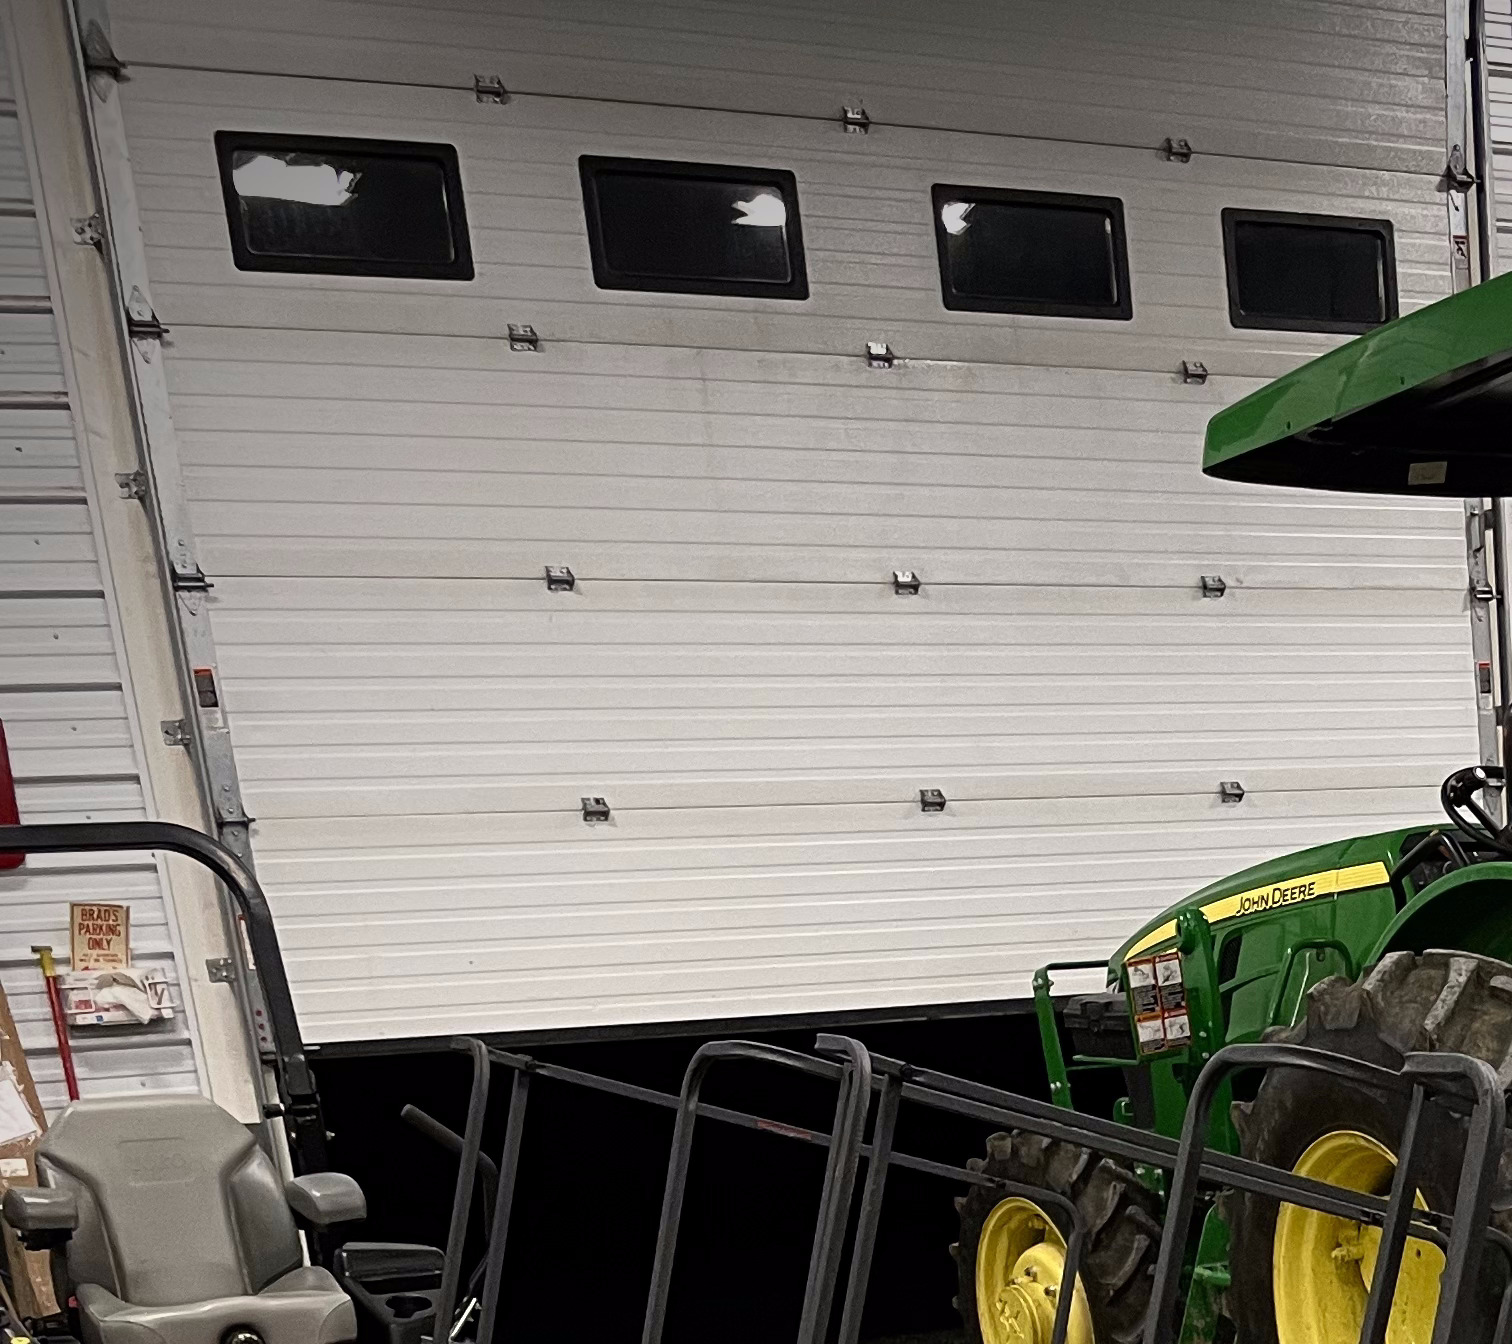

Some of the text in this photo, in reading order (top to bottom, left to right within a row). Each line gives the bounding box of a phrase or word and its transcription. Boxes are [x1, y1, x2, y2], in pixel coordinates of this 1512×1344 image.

[1236, 881, 1315, 915] JOHN DEERE
[78, 922, 121, 937] PARKING
[88, 937, 113, 951] ONLY
